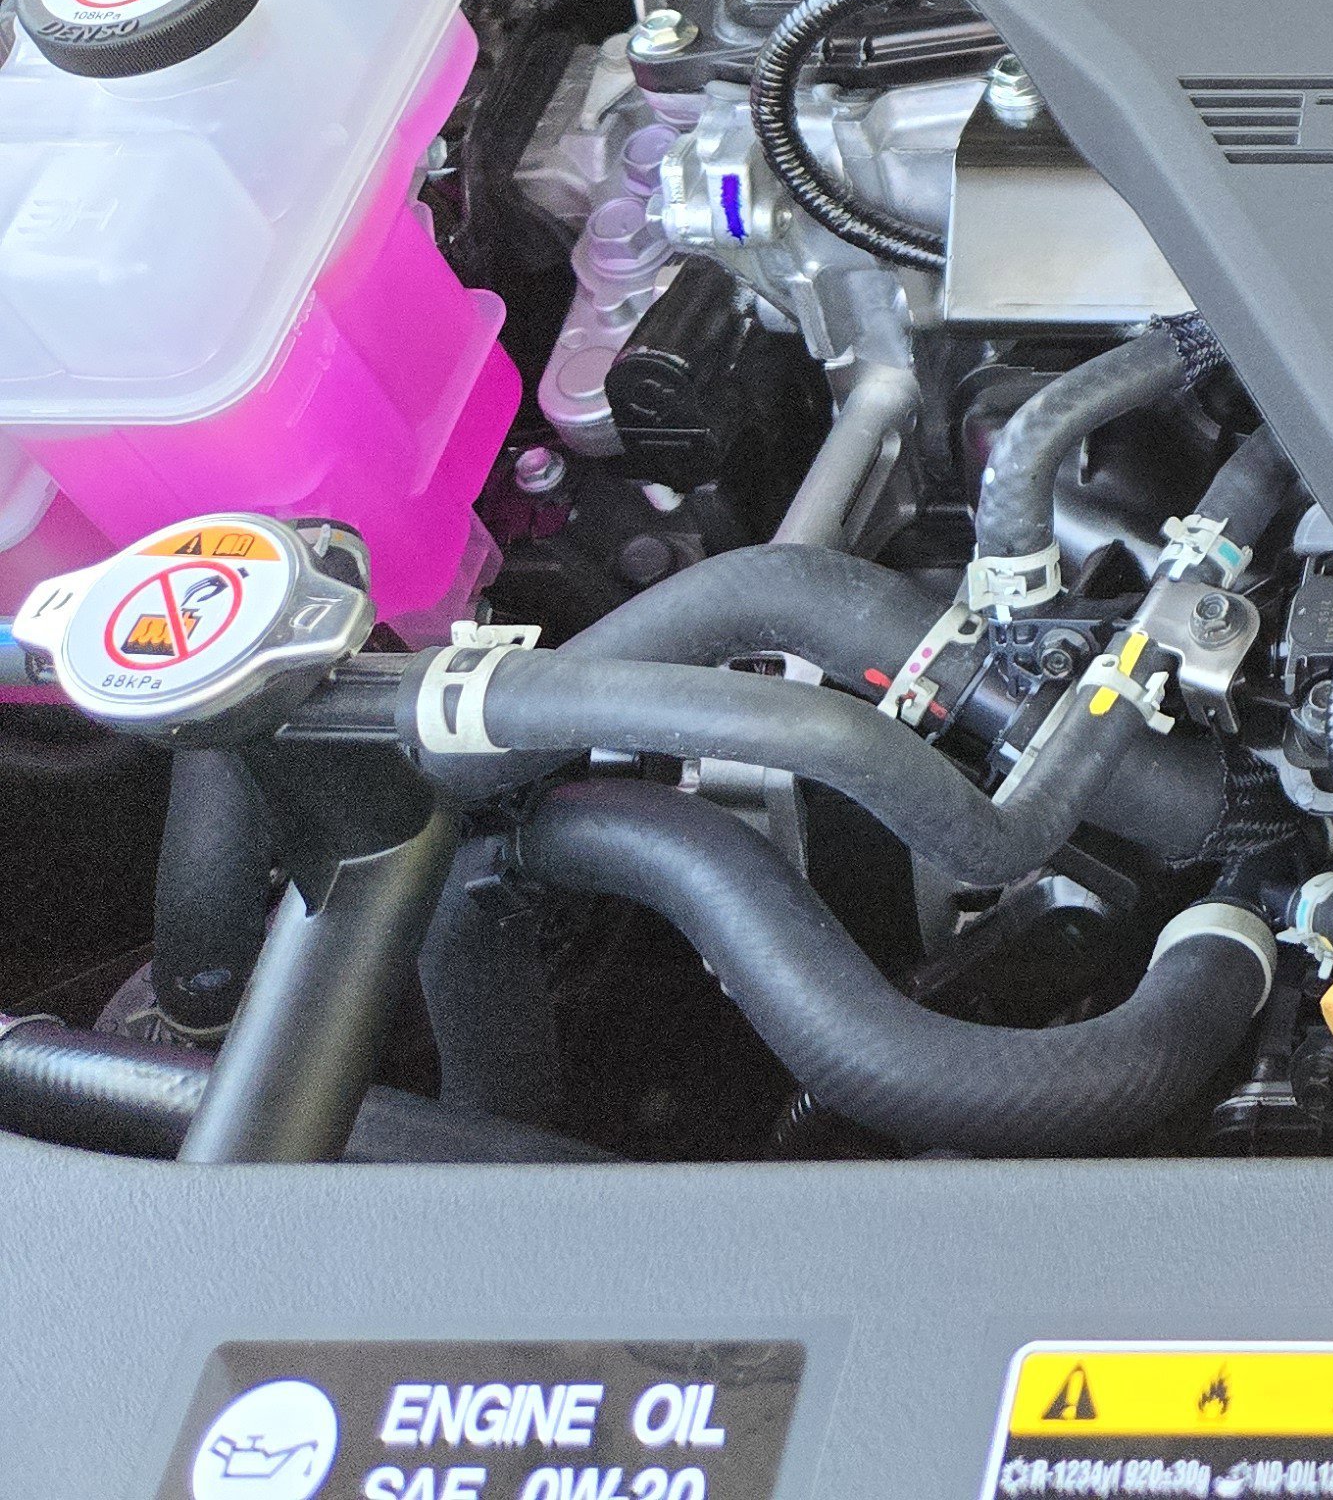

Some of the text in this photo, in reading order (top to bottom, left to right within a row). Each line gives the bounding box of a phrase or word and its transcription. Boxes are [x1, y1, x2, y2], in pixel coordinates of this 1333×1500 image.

[72, 11, 122, 21] 108kPa
[37, 18, 140, 43] DENSO
[101, 672, 164, 690] 88kPa
[380, 1383, 726, 1448] ENGINE OIL
